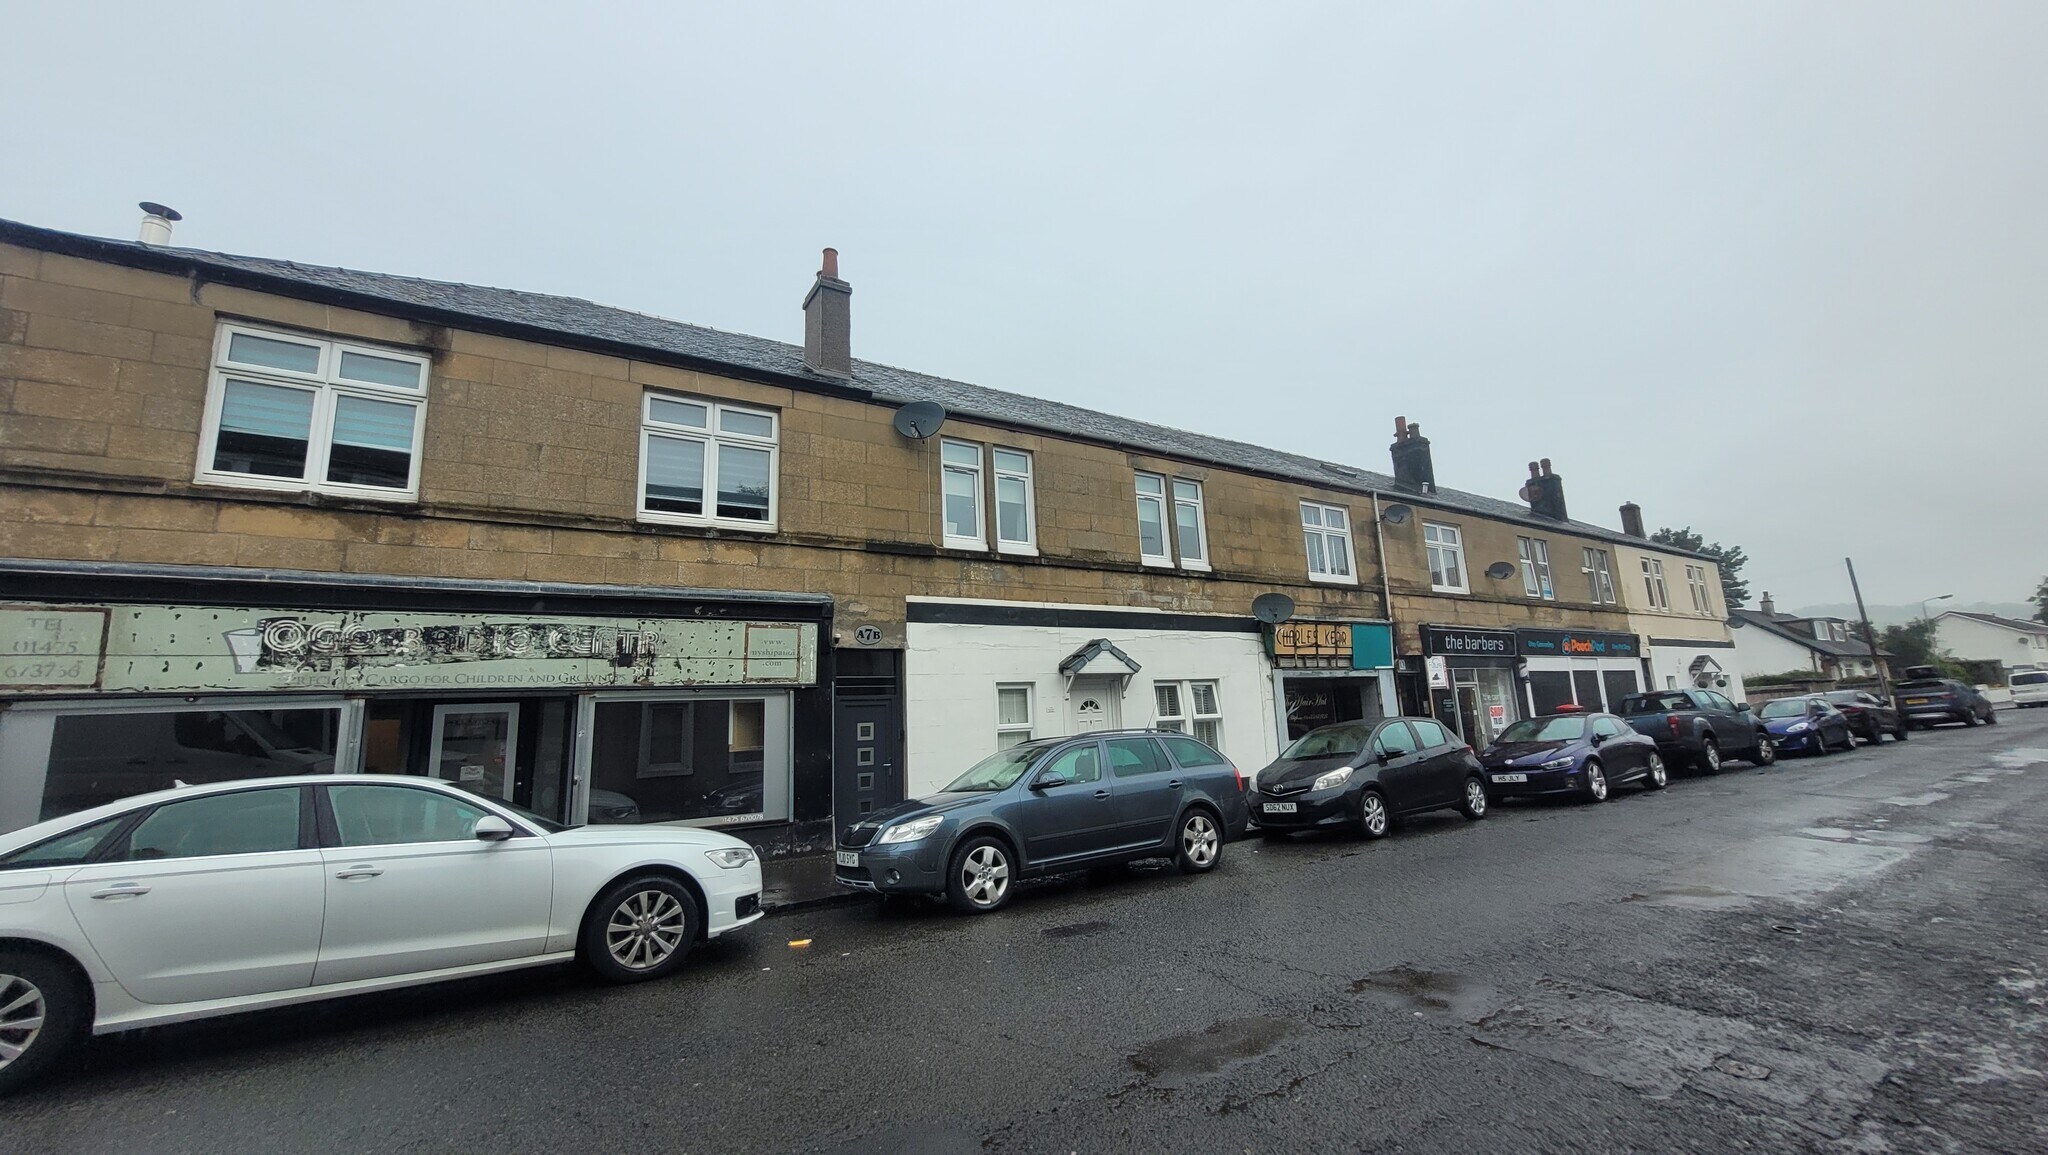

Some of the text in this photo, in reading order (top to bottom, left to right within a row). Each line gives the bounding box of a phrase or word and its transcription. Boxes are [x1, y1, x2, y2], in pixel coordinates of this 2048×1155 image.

[857, 628, 880, 641] A7B
[1445, 634, 1504, 651] the barbers
[1571, 639, 1605, 652] PoochPod
[424, 675, 455, 684] FOR
[455, 673, 523, 684] CHILDREN
[529, 674, 555, 683] AND
